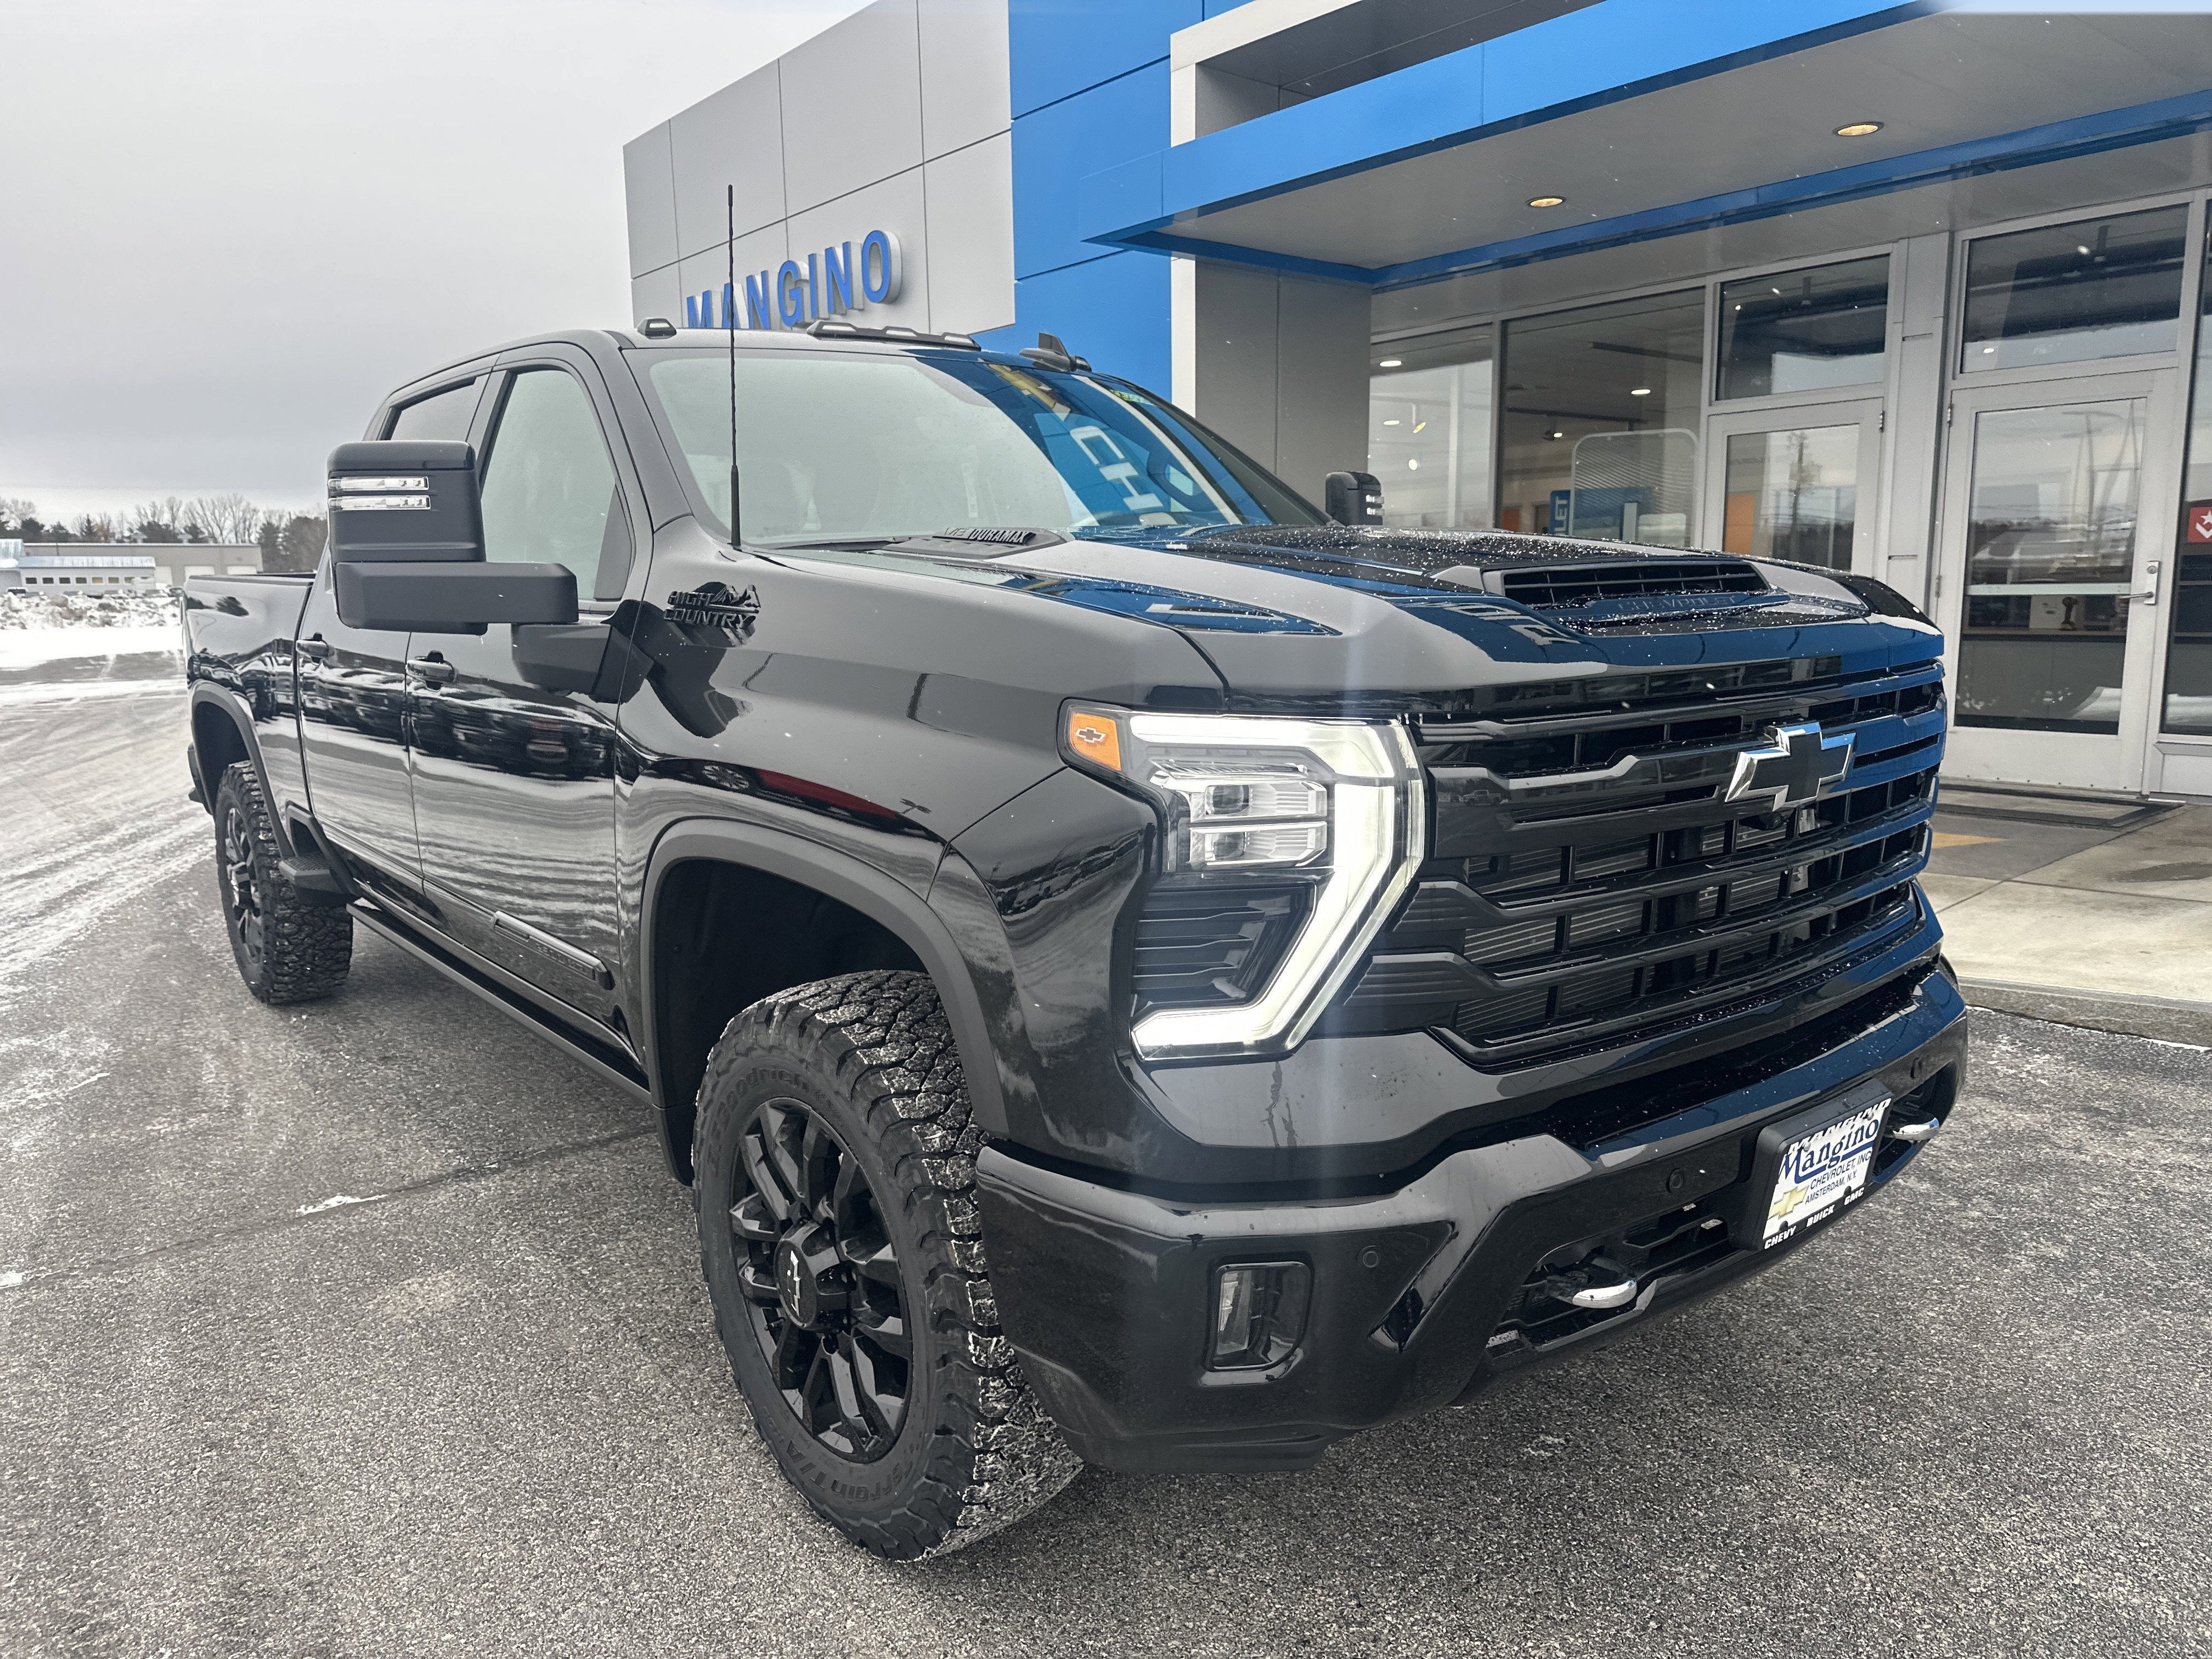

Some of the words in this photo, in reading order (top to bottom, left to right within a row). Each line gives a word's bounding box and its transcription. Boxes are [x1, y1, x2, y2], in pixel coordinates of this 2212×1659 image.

[686, 229, 900, 330] MANGINO
[969, 529, 1028, 543] DURAMAX
[668, 591, 714, 606] HIGH
[1618, 596, 1735, 611] CHEVROLET
[663, 608, 757, 629] COUNTRY
[1779, 1119, 1880, 1183] Mangino
[1764, 1226, 1796, 1249] CHEVY
[1807, 1204, 1835, 1227] BUICK
[1844, 1187, 1864, 1205] GMC
